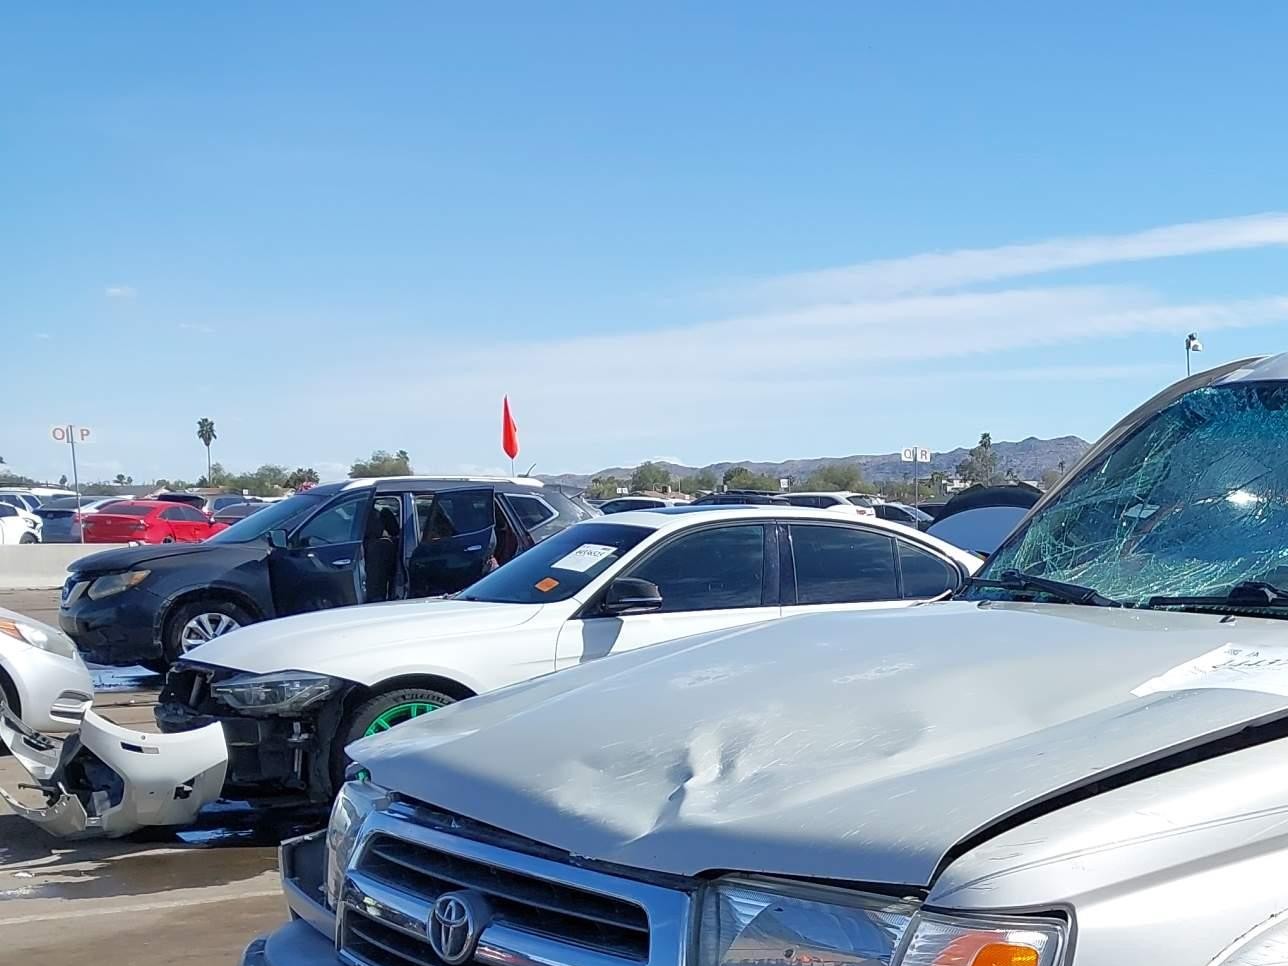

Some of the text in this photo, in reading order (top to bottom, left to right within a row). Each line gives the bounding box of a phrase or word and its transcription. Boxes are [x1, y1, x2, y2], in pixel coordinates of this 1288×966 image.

[52, 427, 65, 441] O
[80, 428, 91, 441] P
[920, 449, 928, 461] R
